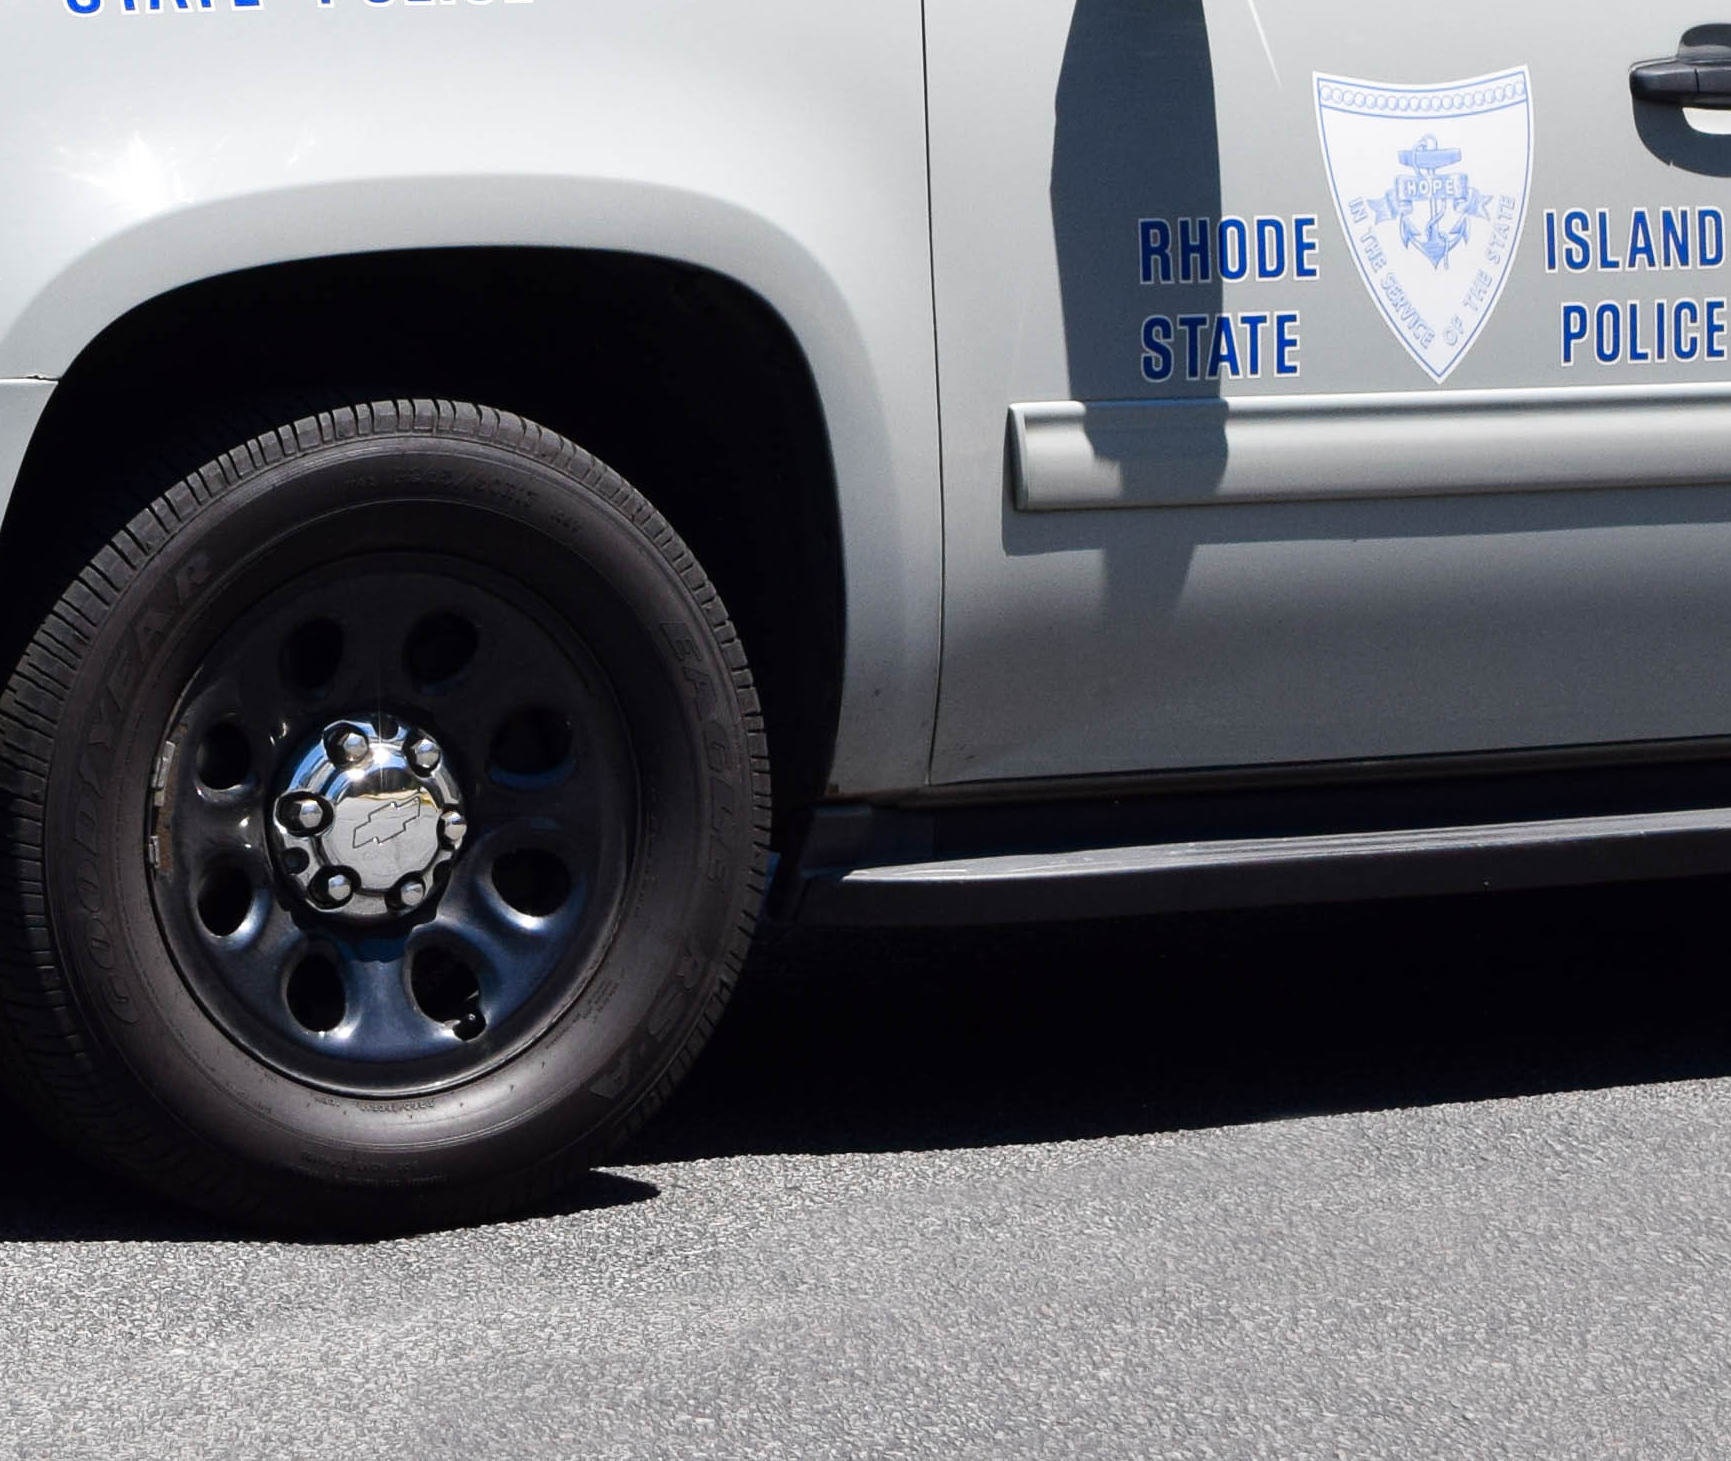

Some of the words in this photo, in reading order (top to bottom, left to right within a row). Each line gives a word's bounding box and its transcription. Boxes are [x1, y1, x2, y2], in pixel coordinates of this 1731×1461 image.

[1406, 179, 1455, 196] HOPE
[1139, 215, 1319, 284] RHODE
[1544, 206, 1725, 274] ISLAND
[1349, 197, 1368, 223] IN
[1359, 226, 1387, 274] THE
[1382, 275, 1436, 348] SERVICE
[1443, 314, 1464, 347] OF
[1460, 268, 1493, 312] THE
[1487, 195, 1516, 264] STATE
[1141, 310, 1300, 382] STATE
[1561, 298, 1727, 366] POLICE
